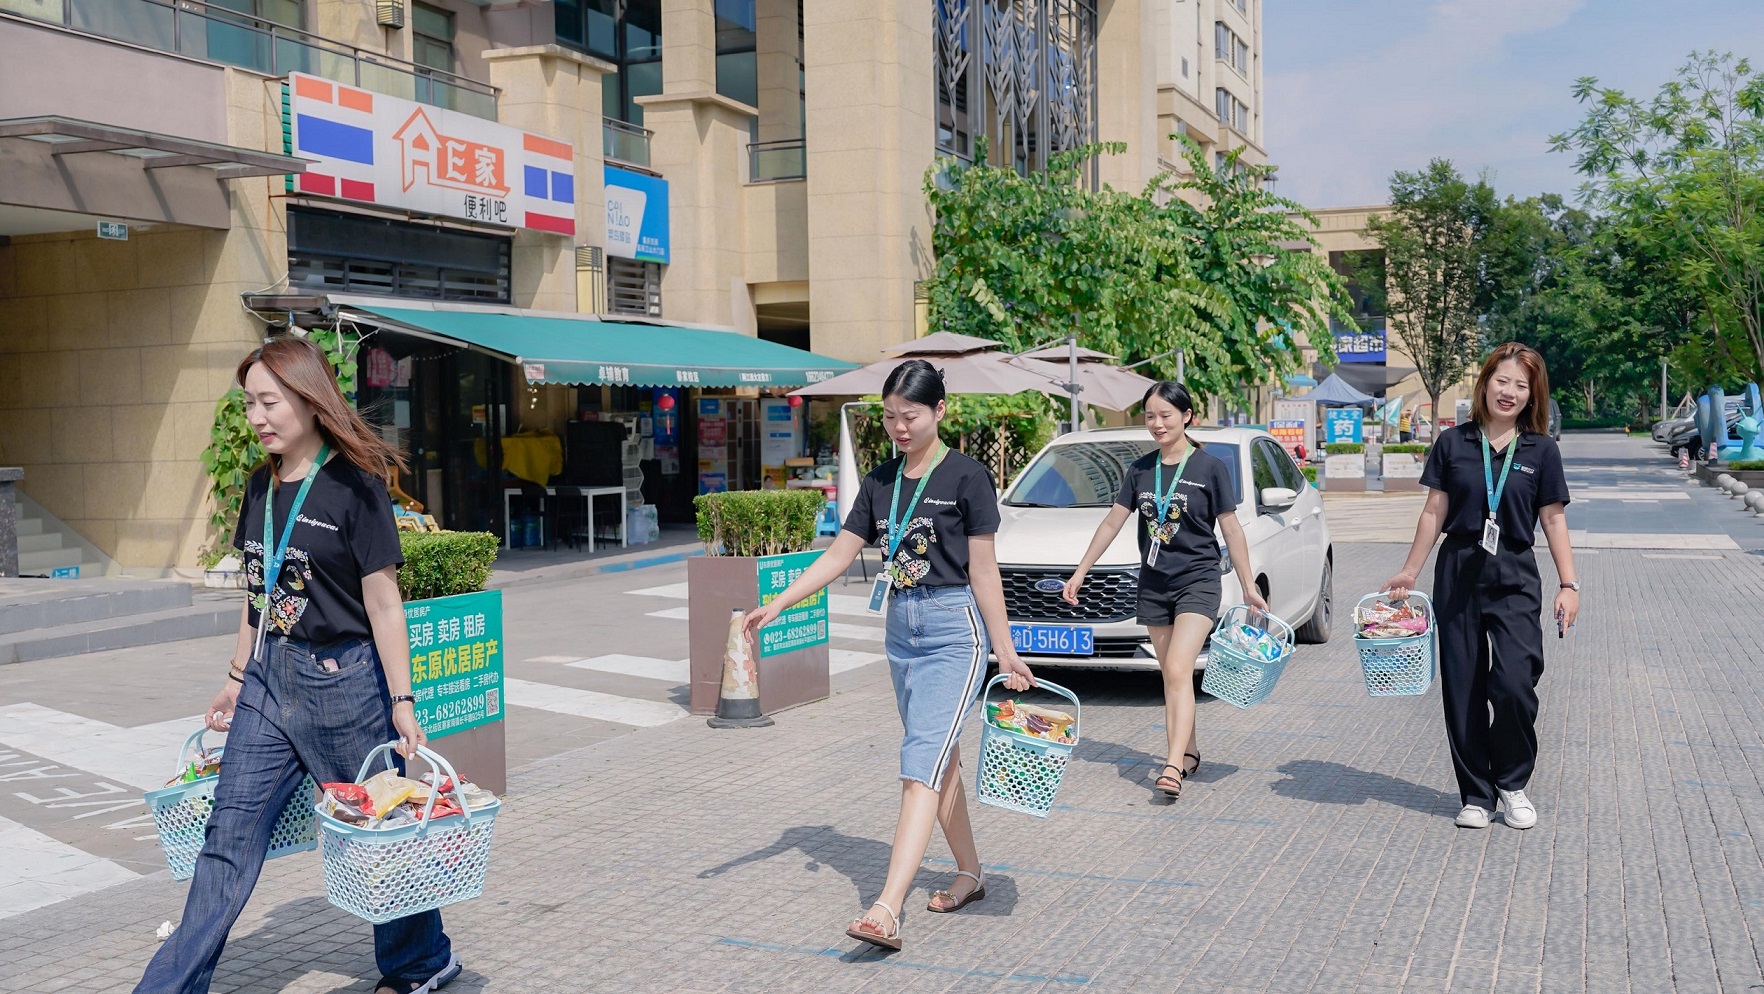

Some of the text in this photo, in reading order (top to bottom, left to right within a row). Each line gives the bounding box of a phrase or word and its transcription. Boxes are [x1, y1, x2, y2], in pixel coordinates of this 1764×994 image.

[463, 193, 508, 223] 便利吧
[607, 199, 624, 214] CAI
[607, 212, 631, 227] NIAO
[1330, 335, 1384, 353] 家超市
[1333, 419, 1354, 436] 药
[771, 570, 786, 589] 买房
[1042, 581, 1061, 590] Ford
[409, 612, 486, 650] 买房 卖房 租房
[770, 624, 816, 643] 023-68262899
[411, 638, 498, 684] 东原优居房产
[472, 671, 499, 689] 二手房代办
